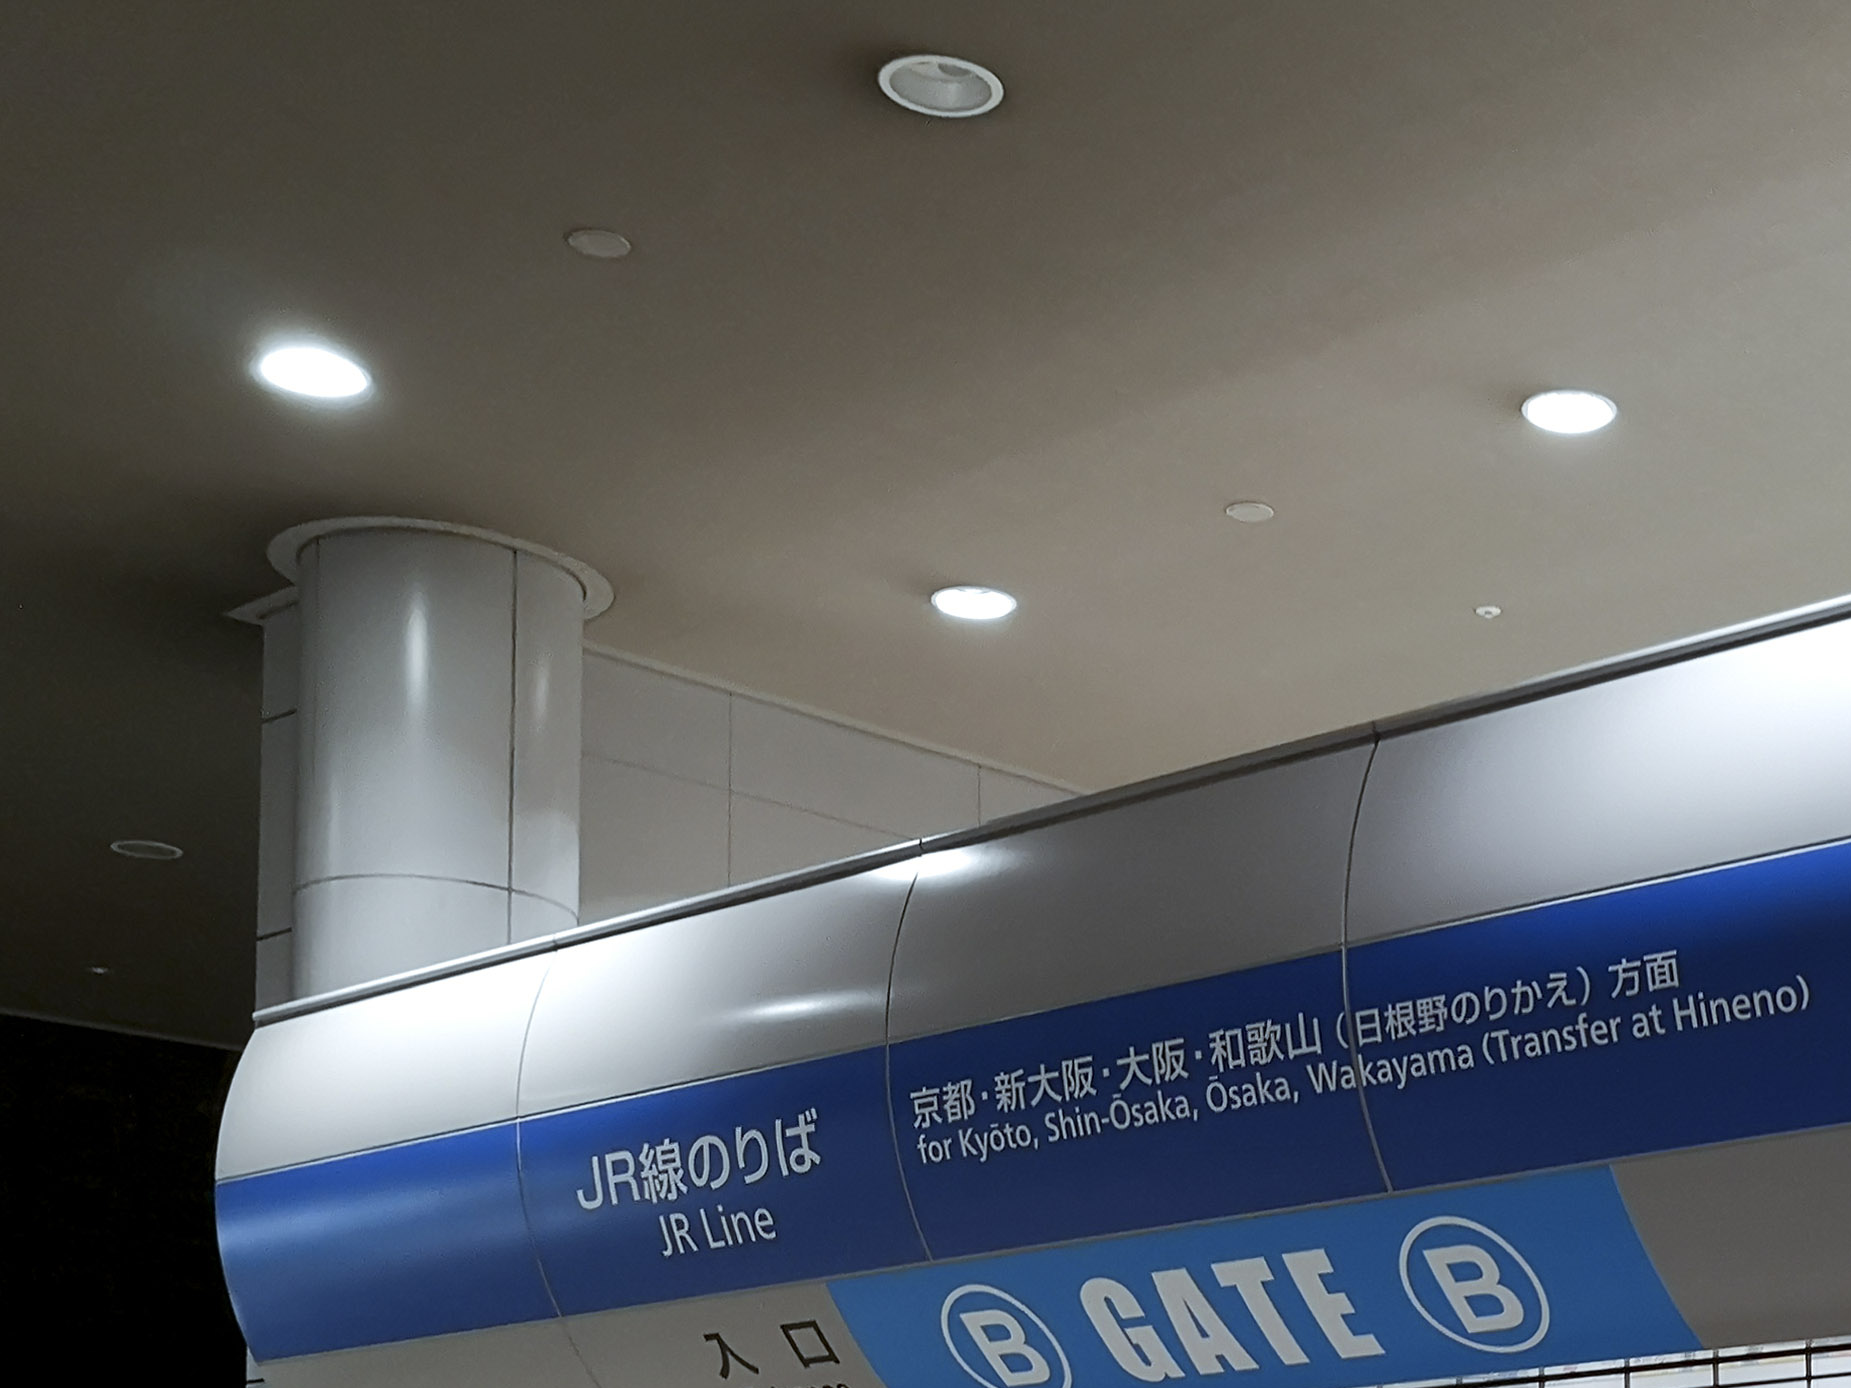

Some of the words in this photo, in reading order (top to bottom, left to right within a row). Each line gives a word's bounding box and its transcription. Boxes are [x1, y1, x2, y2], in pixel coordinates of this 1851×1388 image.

[917, 1133, 952, 1164] for
[959, 1123, 1039, 1162] Kyōto,
[1307, 1043, 1474, 1095] Wakayama
[1482, 1012, 1621, 1066] (Transfer
[1632, 1004, 1665, 1039] at
[1674, 976, 1811, 1031] Hineno)
[577, 1108, 822, 1210] JR線のりば
[659, 1213, 698, 1258] JR
[701, 1204, 777, 1250] Line
[960, 1309, 1051, 1388] B
[1079, 1248, 1386, 1383] GATE
[1421, 1244, 1525, 1334] B
